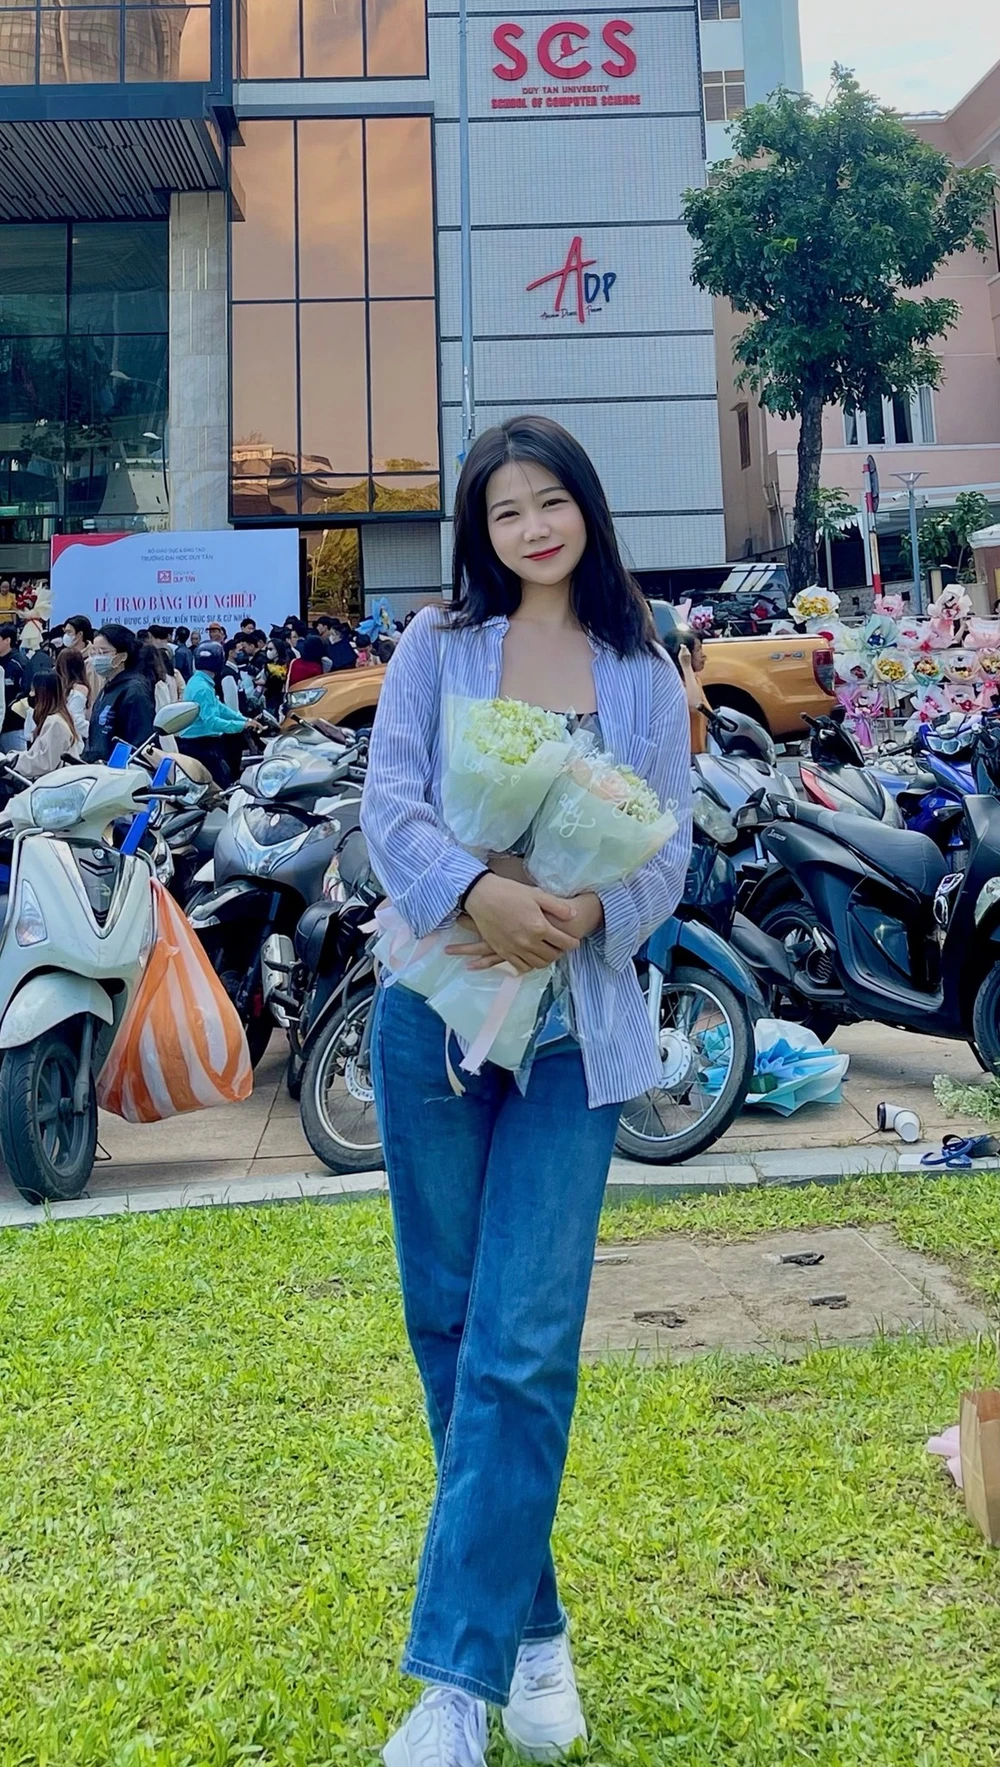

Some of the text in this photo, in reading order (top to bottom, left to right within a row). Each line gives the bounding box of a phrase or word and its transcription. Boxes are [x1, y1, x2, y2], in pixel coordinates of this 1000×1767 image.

[492, 20, 637, 81] SCS
[522, 85, 609, 95] DUY TAN UNIVERSITY
[491, 95, 641, 109] SCHOOL OF COMPUTER SCIENCE
[526, 236, 617, 323] ADP
[95, 589, 257, 612] LỄ TRAO BẰNG TỐT NGHIỆP
